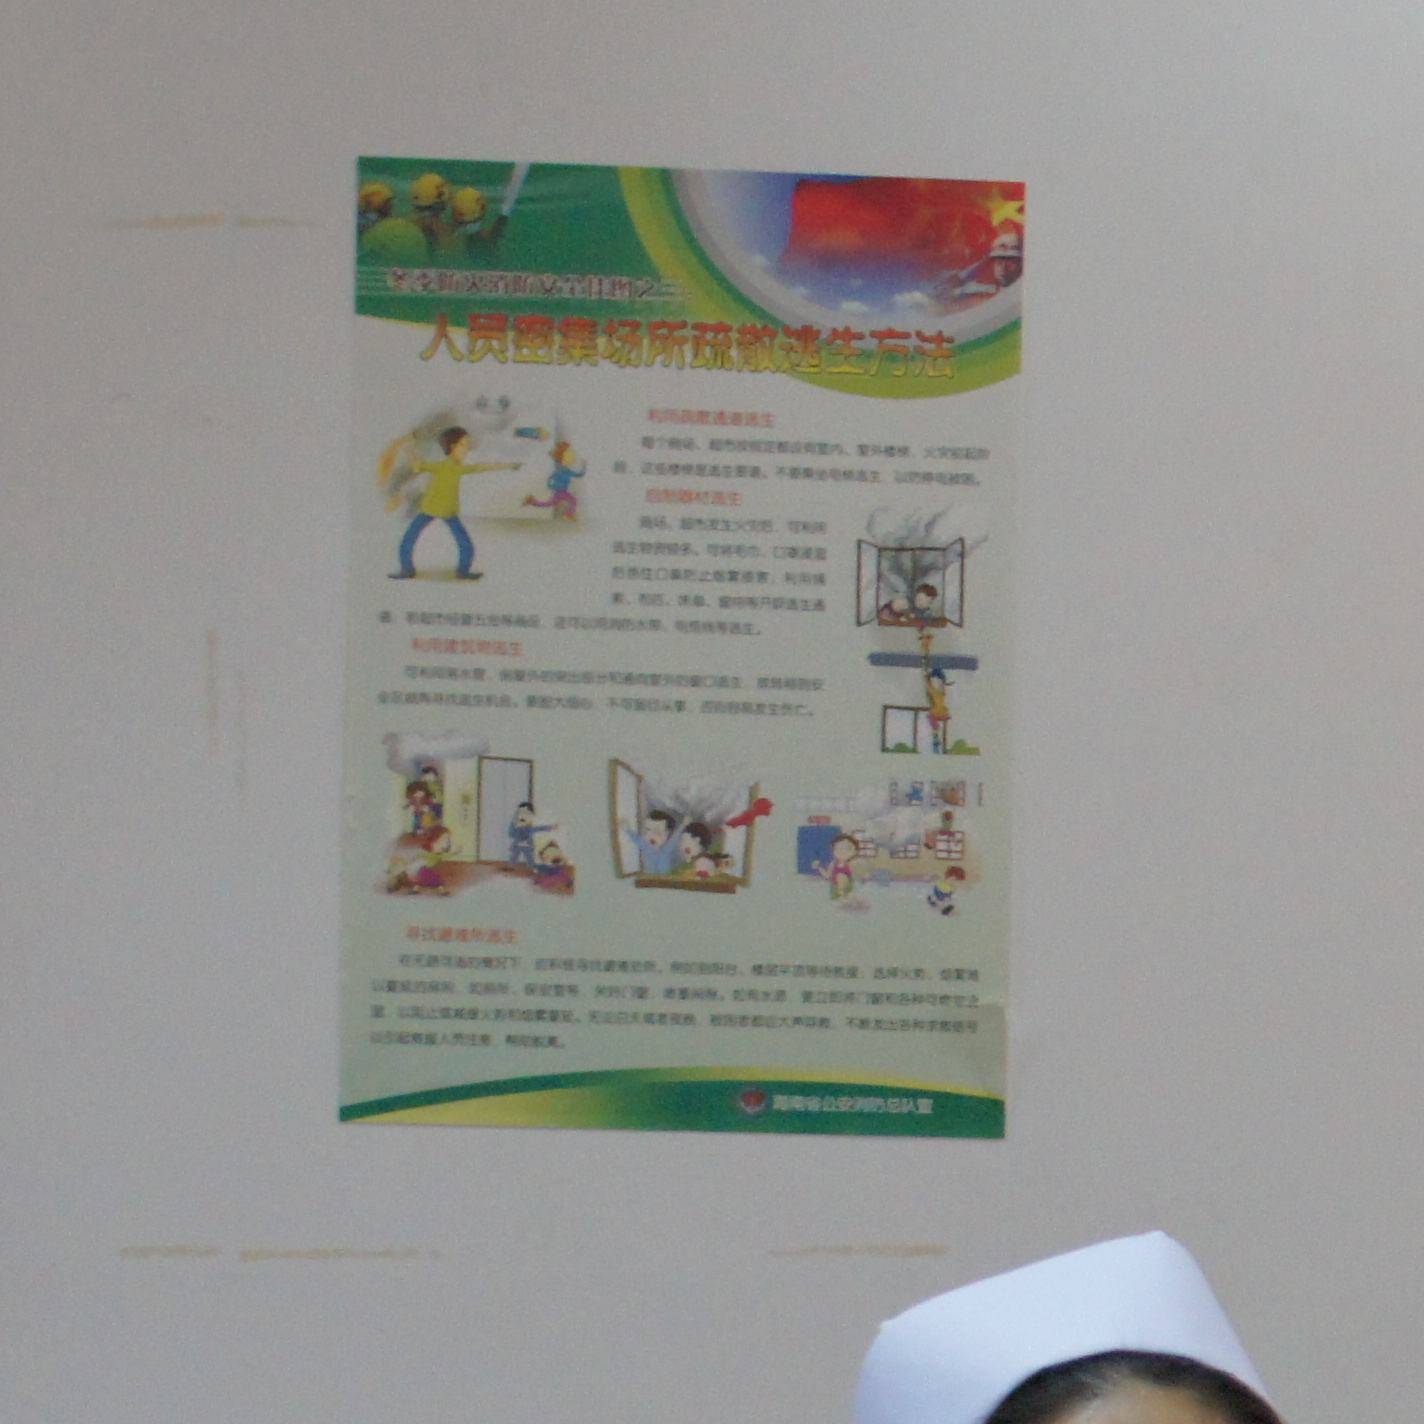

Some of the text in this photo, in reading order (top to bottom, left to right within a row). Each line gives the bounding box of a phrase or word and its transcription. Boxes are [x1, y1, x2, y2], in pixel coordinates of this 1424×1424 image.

[419, 312, 956, 380] 人员密集场所疏散逃生方法
